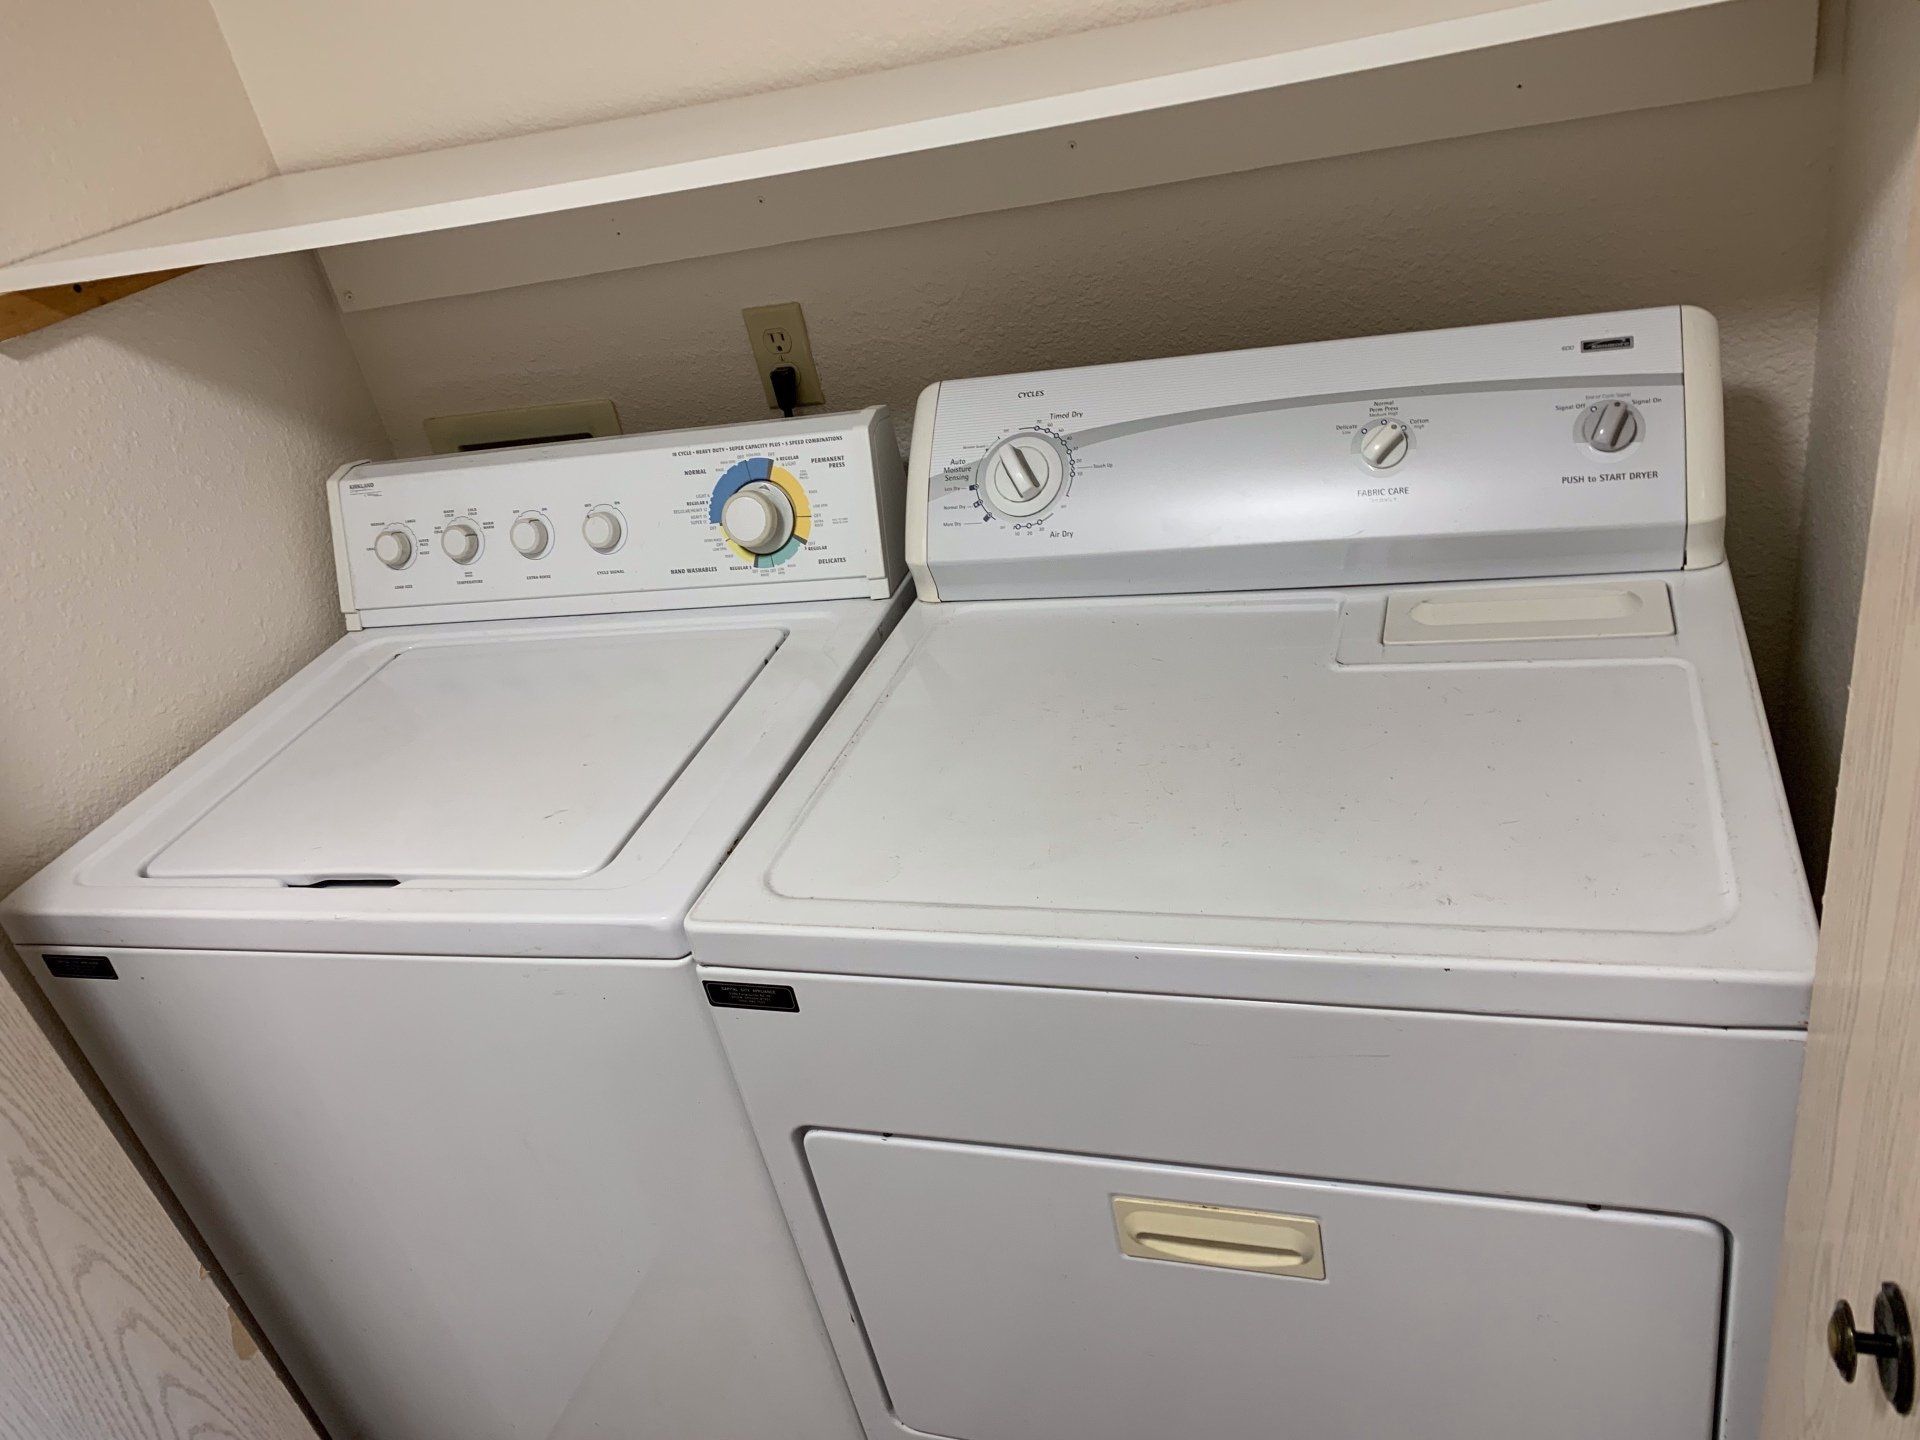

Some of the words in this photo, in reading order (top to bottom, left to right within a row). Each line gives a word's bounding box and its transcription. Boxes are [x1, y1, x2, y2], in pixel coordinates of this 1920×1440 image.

[1018, 390, 1045, 399] CYCLES
[1555, 404, 1574, 412] Signal
[1050, 412, 1070, 420] Timed
[1071, 411, 1084, 419] Dry
[806, 436, 843, 445] COMBINATIONS
[811, 456, 845, 464] PERMANENT
[951, 458, 966, 466] Auto
[944, 466, 972, 474] Moisture
[944, 473, 969, 482] Sensing
[1562, 476, 1585, 484] PUSH
[1600, 473, 1626, 482] START
[1630, 471, 1659, 480] DRYER
[1357, 488, 1385, 497] FABRIC
[1388, 487, 1410, 496] CARE
[1062, 530, 1074, 539] Dry
[818, 557, 847, 565] DELICATES
[687, 566, 718, 574] WASHABLES
